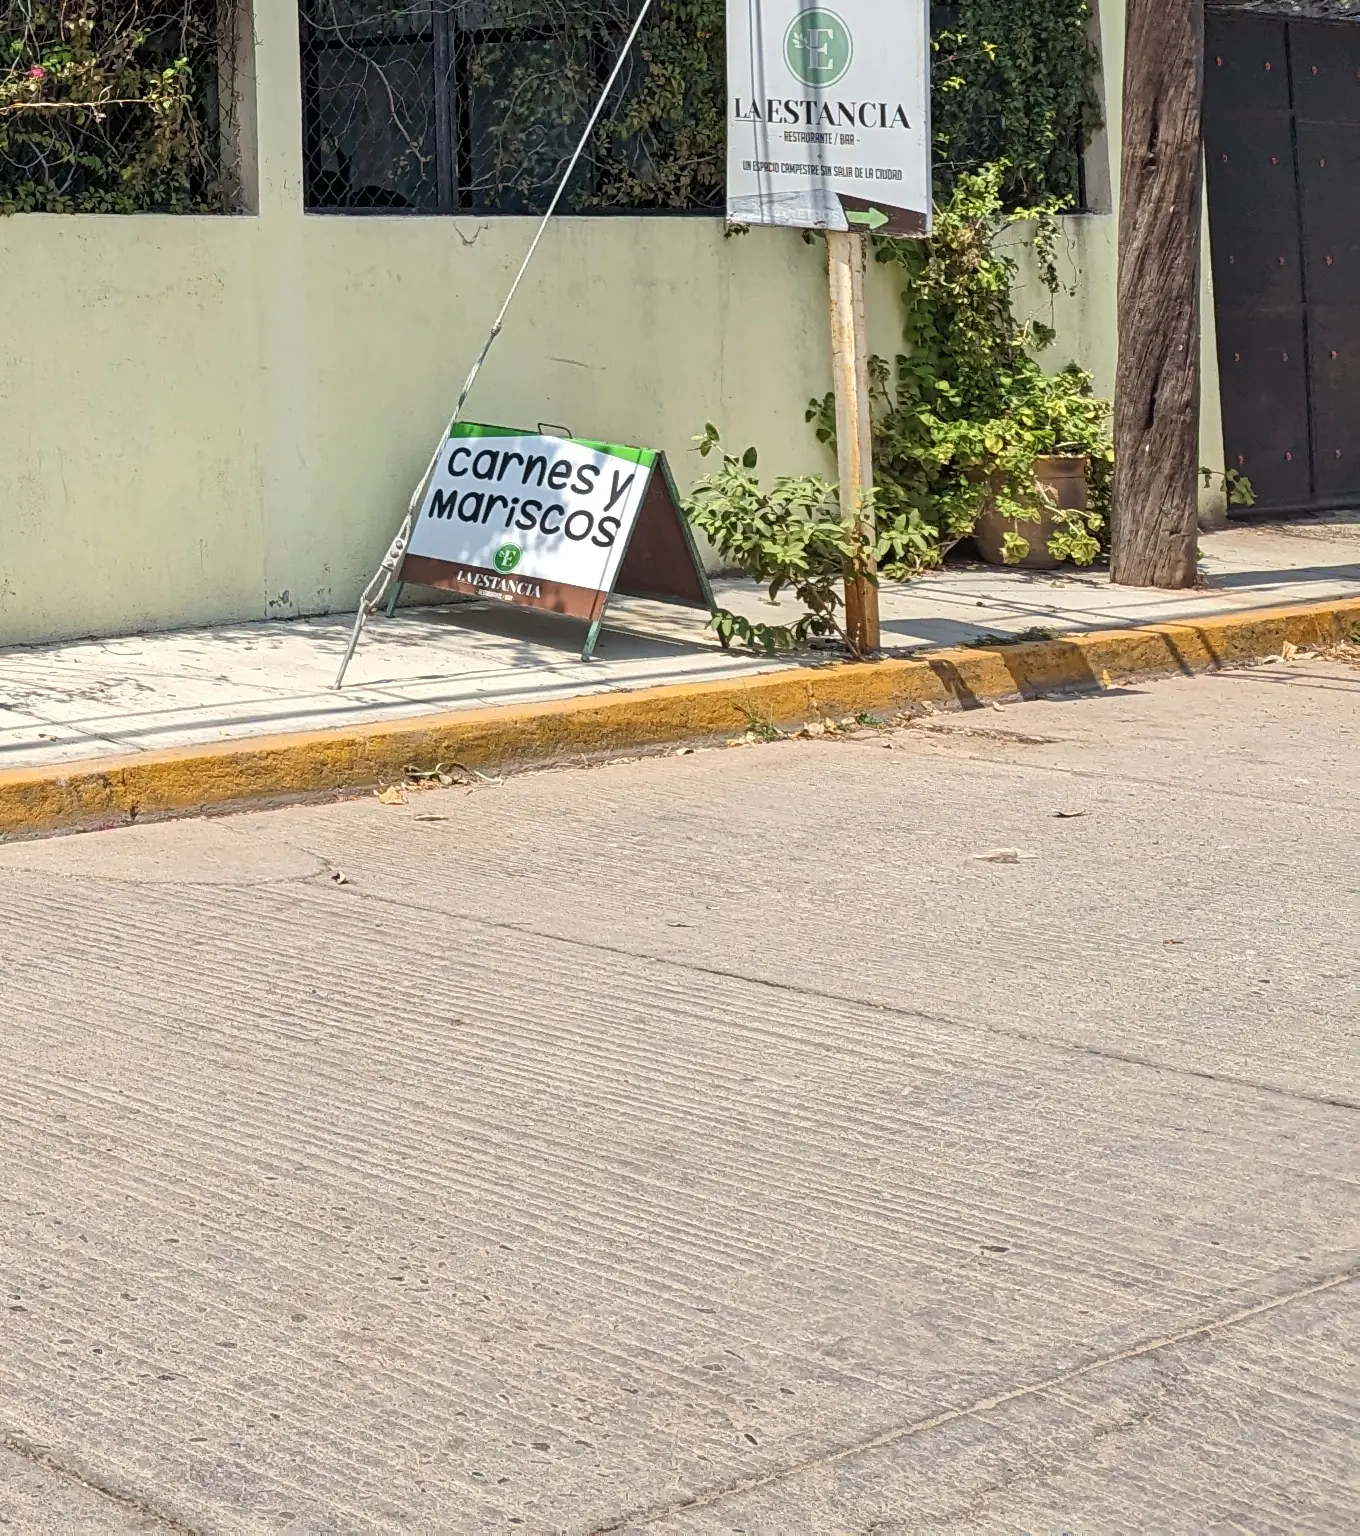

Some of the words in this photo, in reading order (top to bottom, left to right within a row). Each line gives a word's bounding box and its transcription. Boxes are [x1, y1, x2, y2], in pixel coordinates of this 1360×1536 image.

[734, 97, 763, 120] LA
[766, 99, 912, 130] ESTANCIA
[784, 131, 832, 144] RESTAURANTE
[839, 133, 855, 145] BAR
[781, 163, 819, 175] CAMPESTRE
[855, 167, 863, 178] DE
[865, 168, 873, 179] LA
[875, 169, 902, 180] CIUDAD
[457, 570, 471, 583] LA
[473, 573, 540, 598] ESTANCIA
